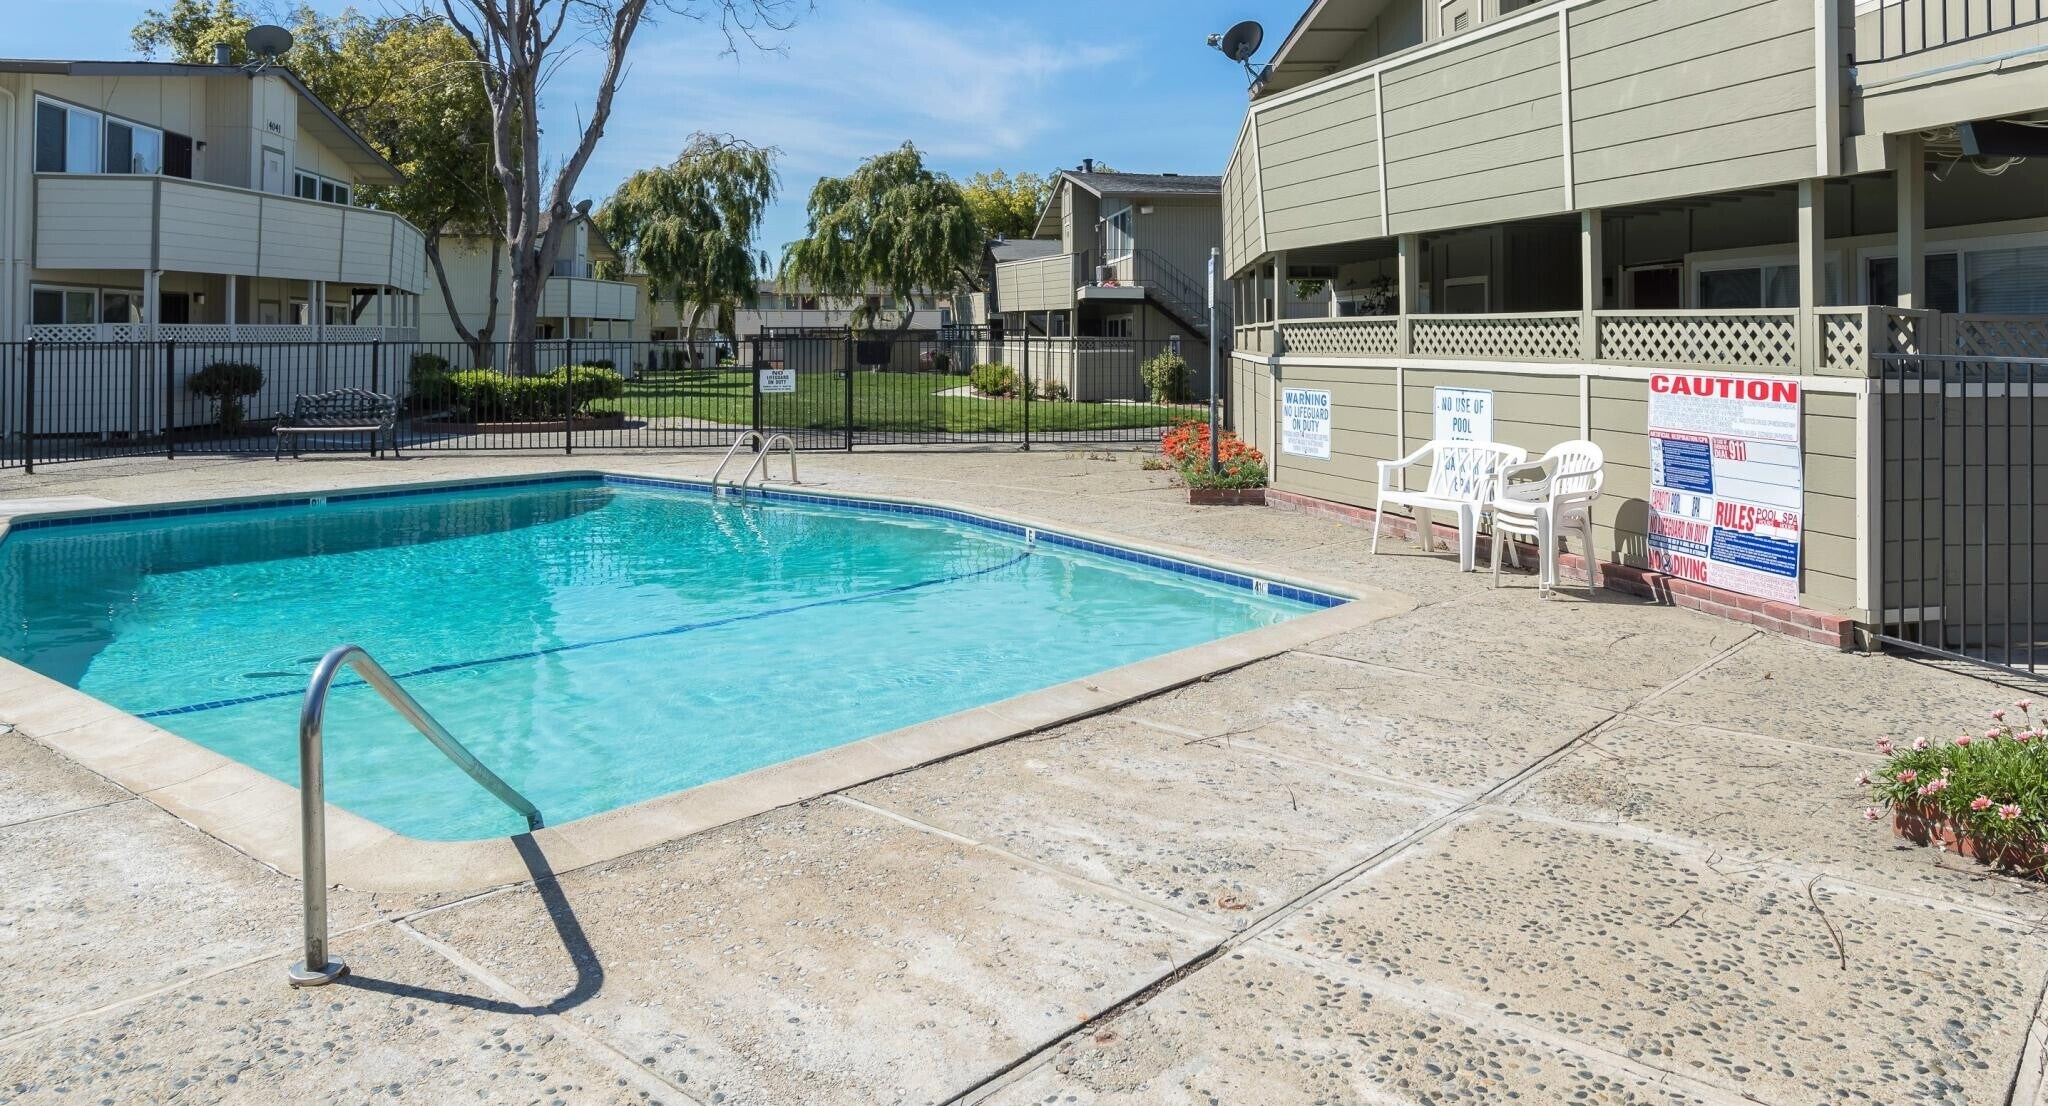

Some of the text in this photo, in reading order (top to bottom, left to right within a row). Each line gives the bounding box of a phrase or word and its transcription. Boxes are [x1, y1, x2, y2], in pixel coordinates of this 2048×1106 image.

[1651, 375, 1797, 403] CAUTION
[1286, 392, 1328, 406] WARNING
[1441, 396, 1484, 414] NO USE OF
[1284, 405, 1329, 421] NO LIFEGUARD
[1292, 418, 1320, 432] ON DUTY
[1452, 417, 1472, 434] POOL
[1728, 440, 1746, 461] 911
[1715, 501, 1798, 532] RULES POOL SPA
[1649, 515, 1709, 544] NO LIFEGUARD ON DUTY
[1648, 548, 1661, 570] NO
[1672, 554, 1708, 583] DIVING
